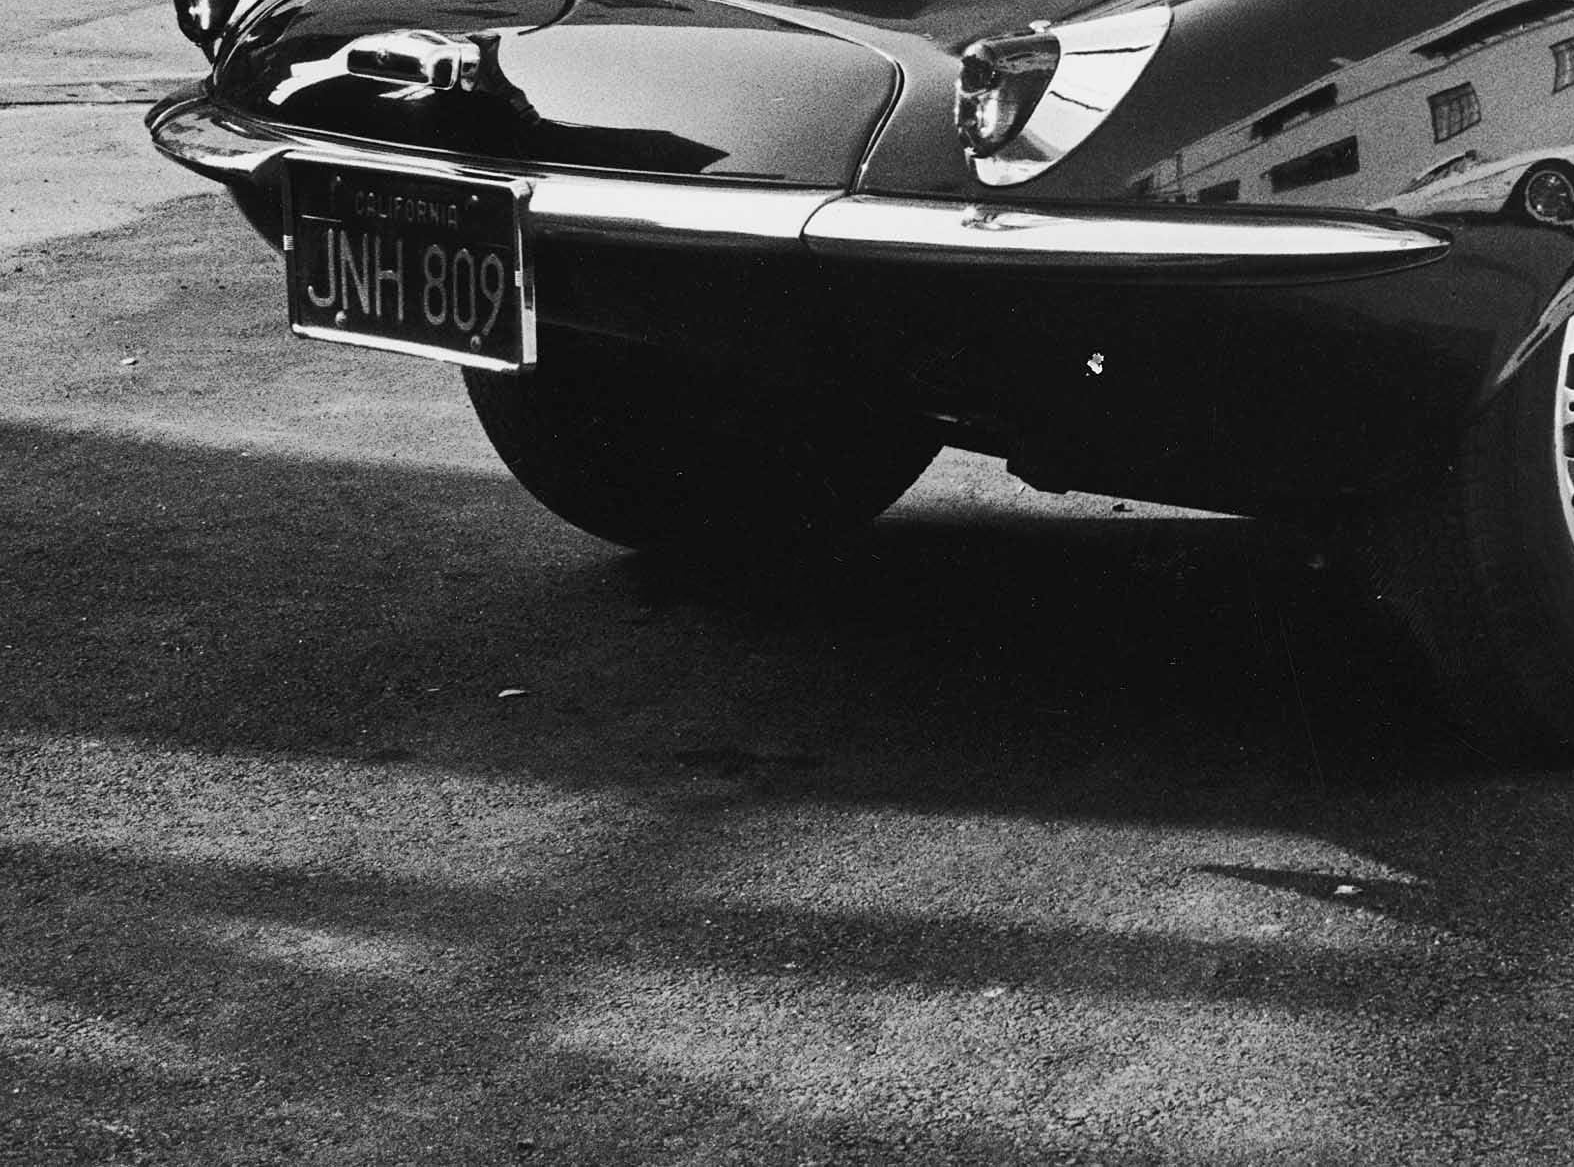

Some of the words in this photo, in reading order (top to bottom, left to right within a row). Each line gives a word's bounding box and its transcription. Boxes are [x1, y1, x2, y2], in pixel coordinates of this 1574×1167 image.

[355, 190, 457, 228] CALIFORNIA
[307, 228, 404, 321] JNH
[423, 243, 504, 335] 809
